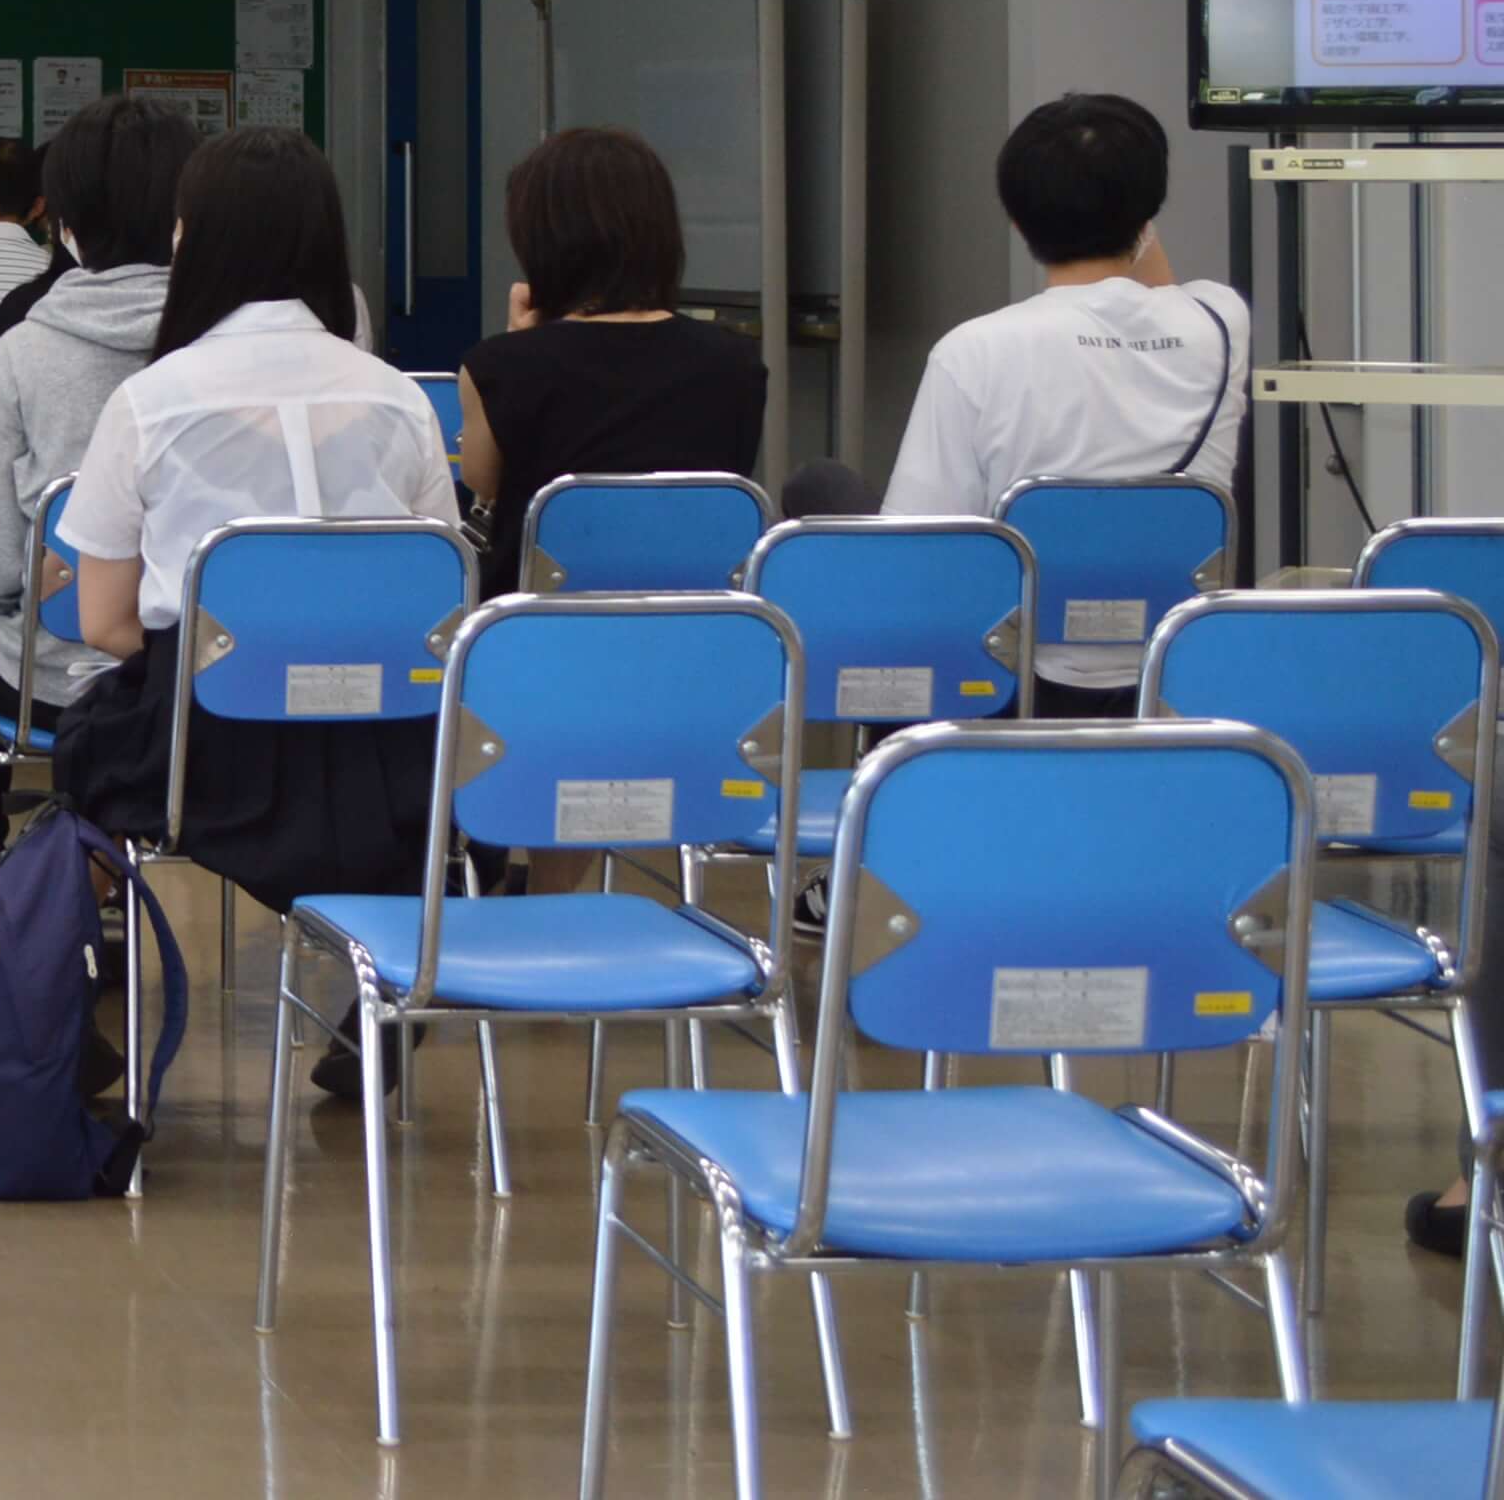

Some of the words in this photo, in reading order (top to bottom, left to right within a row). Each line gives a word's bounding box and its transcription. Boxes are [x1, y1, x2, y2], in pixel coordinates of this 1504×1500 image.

[1077, 335, 1104, 348] DAY
[1106, 337, 1121, 349] IN
[1151, 337, 1184, 350] LIFE
